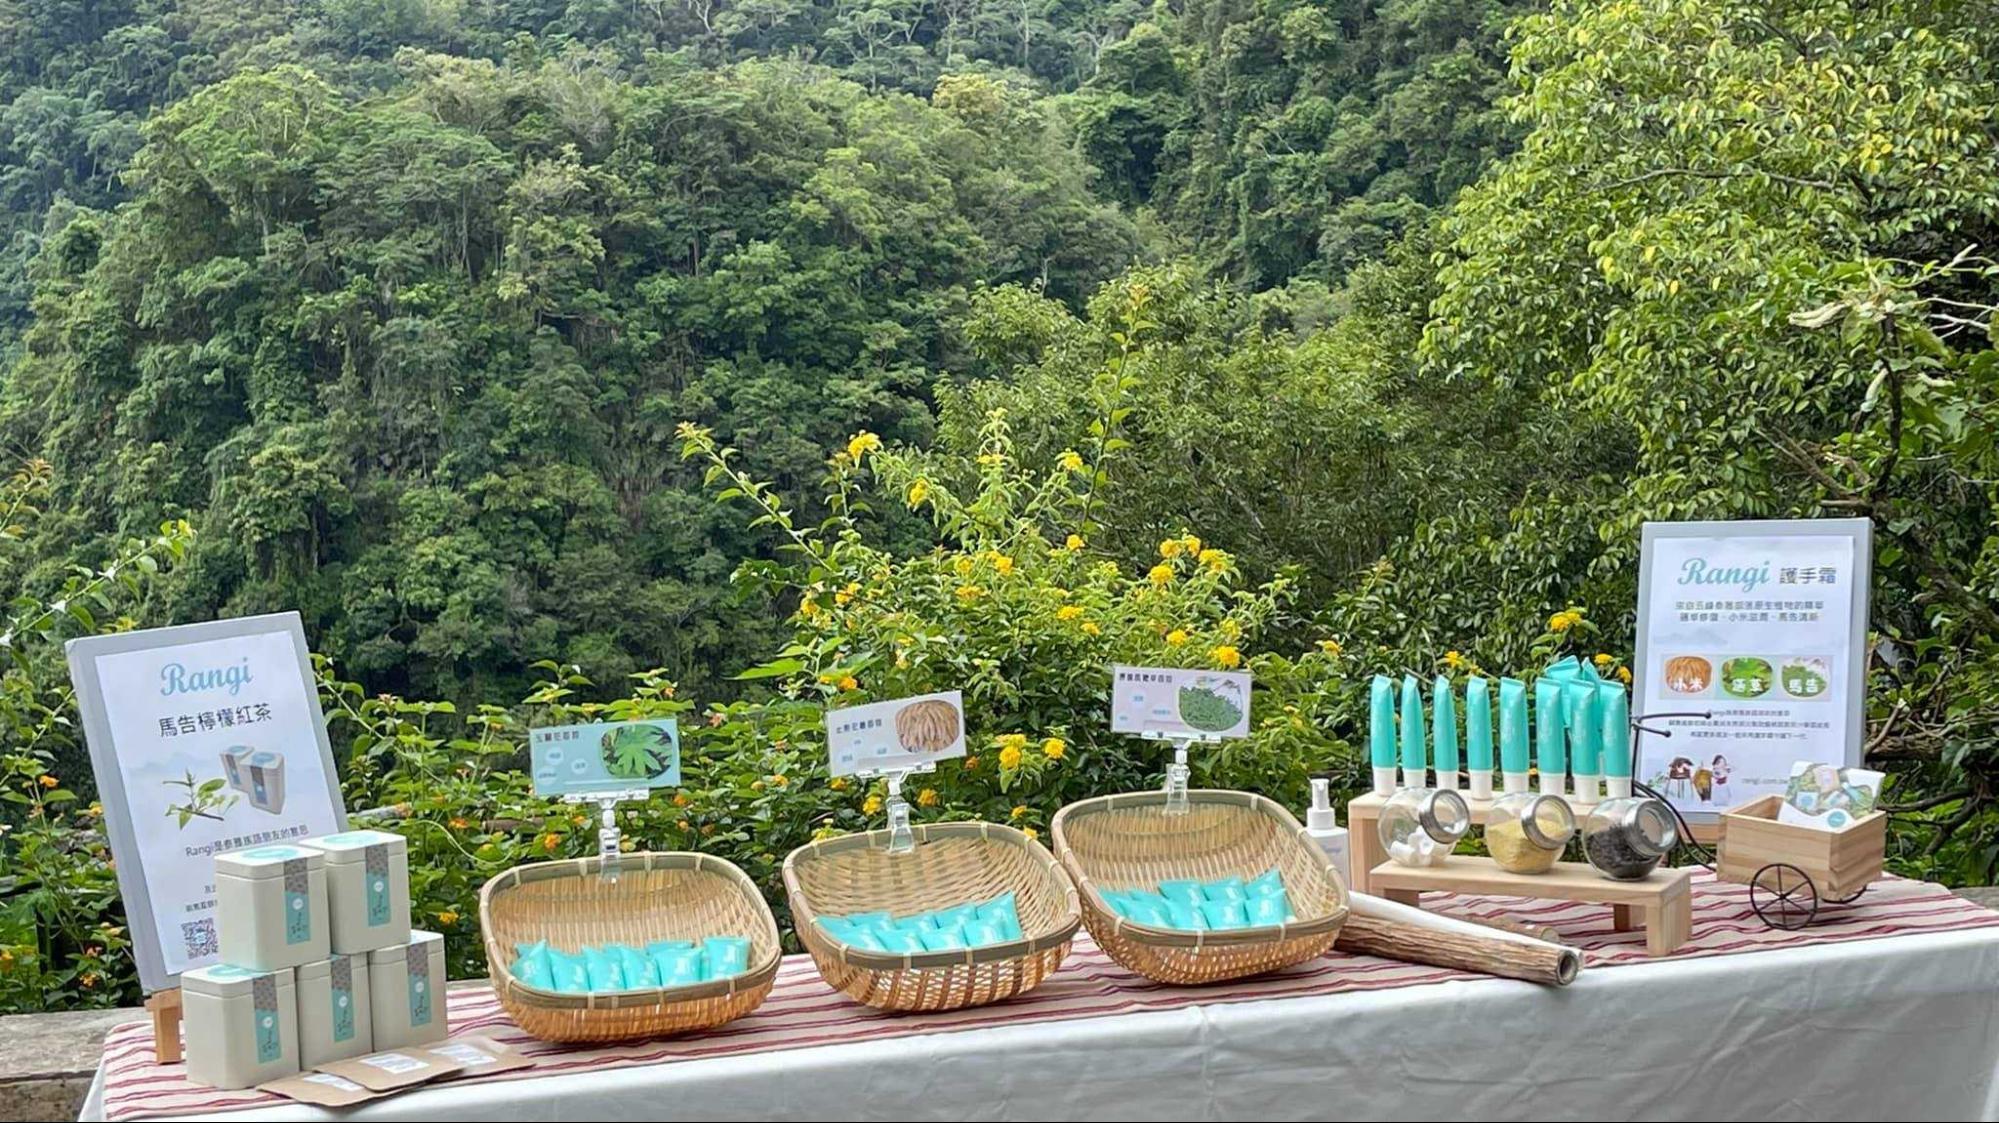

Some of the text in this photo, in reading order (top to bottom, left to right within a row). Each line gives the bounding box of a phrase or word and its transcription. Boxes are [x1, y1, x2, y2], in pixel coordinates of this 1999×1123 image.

[1677, 557, 1837, 593] Rangi 護手霜
[160, 656, 254, 696] Rangi
[1673, 677, 1703, 691] 小米
[1789, 678, 1819, 692] 馬告
[159, 702, 272, 737] 馬告檸檬紅茶
